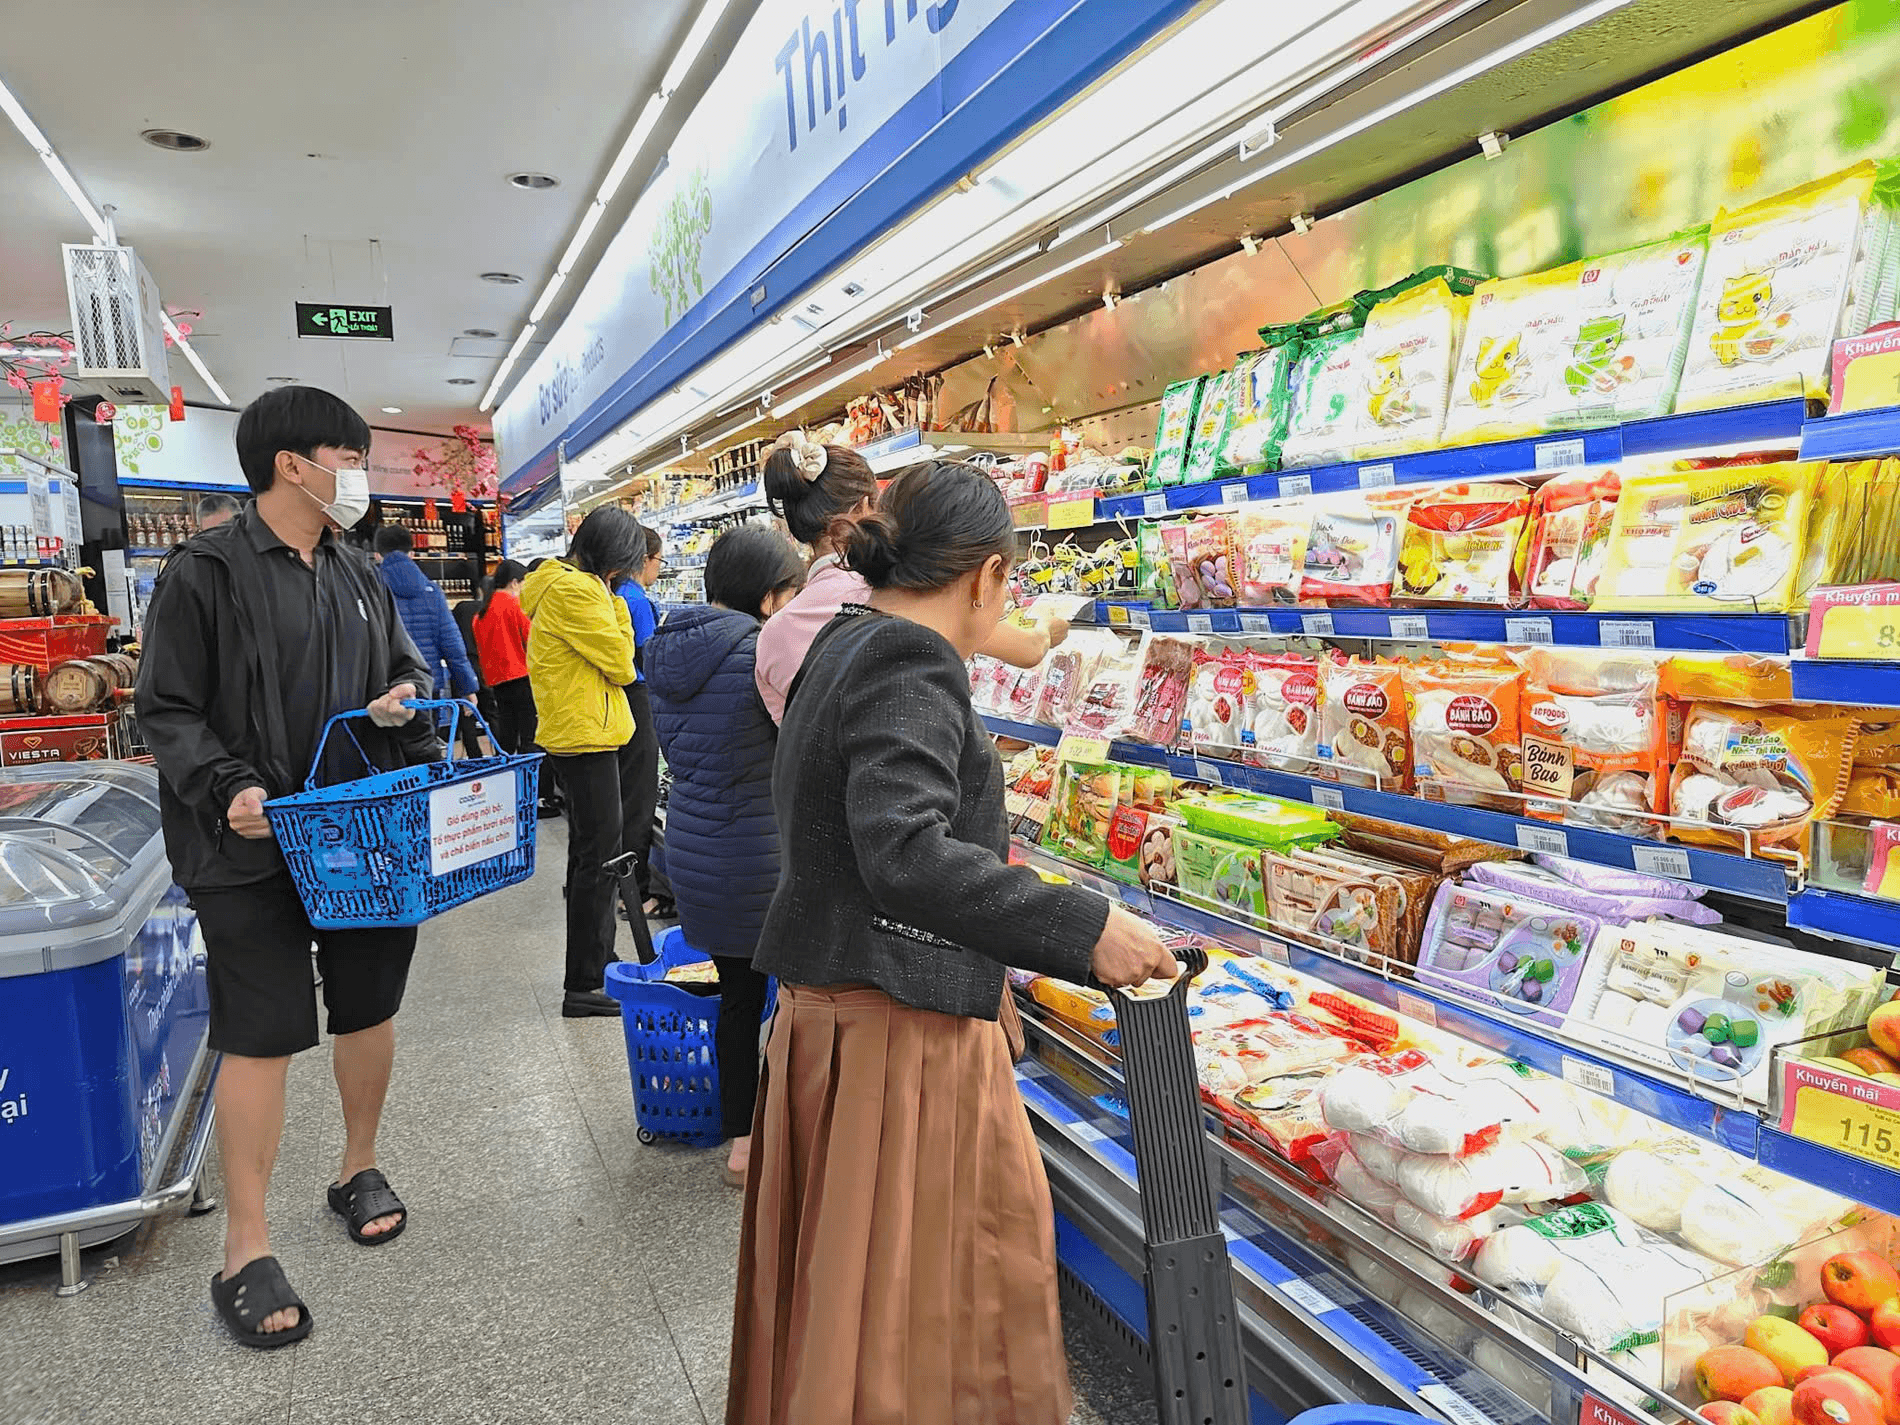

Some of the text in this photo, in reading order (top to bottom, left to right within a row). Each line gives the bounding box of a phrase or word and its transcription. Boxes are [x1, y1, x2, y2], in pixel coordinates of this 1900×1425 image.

[349, 310, 377, 322] EXIT
[1826, 588, 1881, 606] Khuyến
[1347, 693, 1383, 707] BÁNH BAO
[1450, 707, 1492, 722] BÁNH BAO
[1543, 708, 1566, 719] FOODS
[9, 749, 60, 760] VIESTA
[1527, 744, 1567, 767] Bánh
[1530, 763, 1561, 783] Bao
[1796, 1068, 1879, 1100] Khuyến mãi
